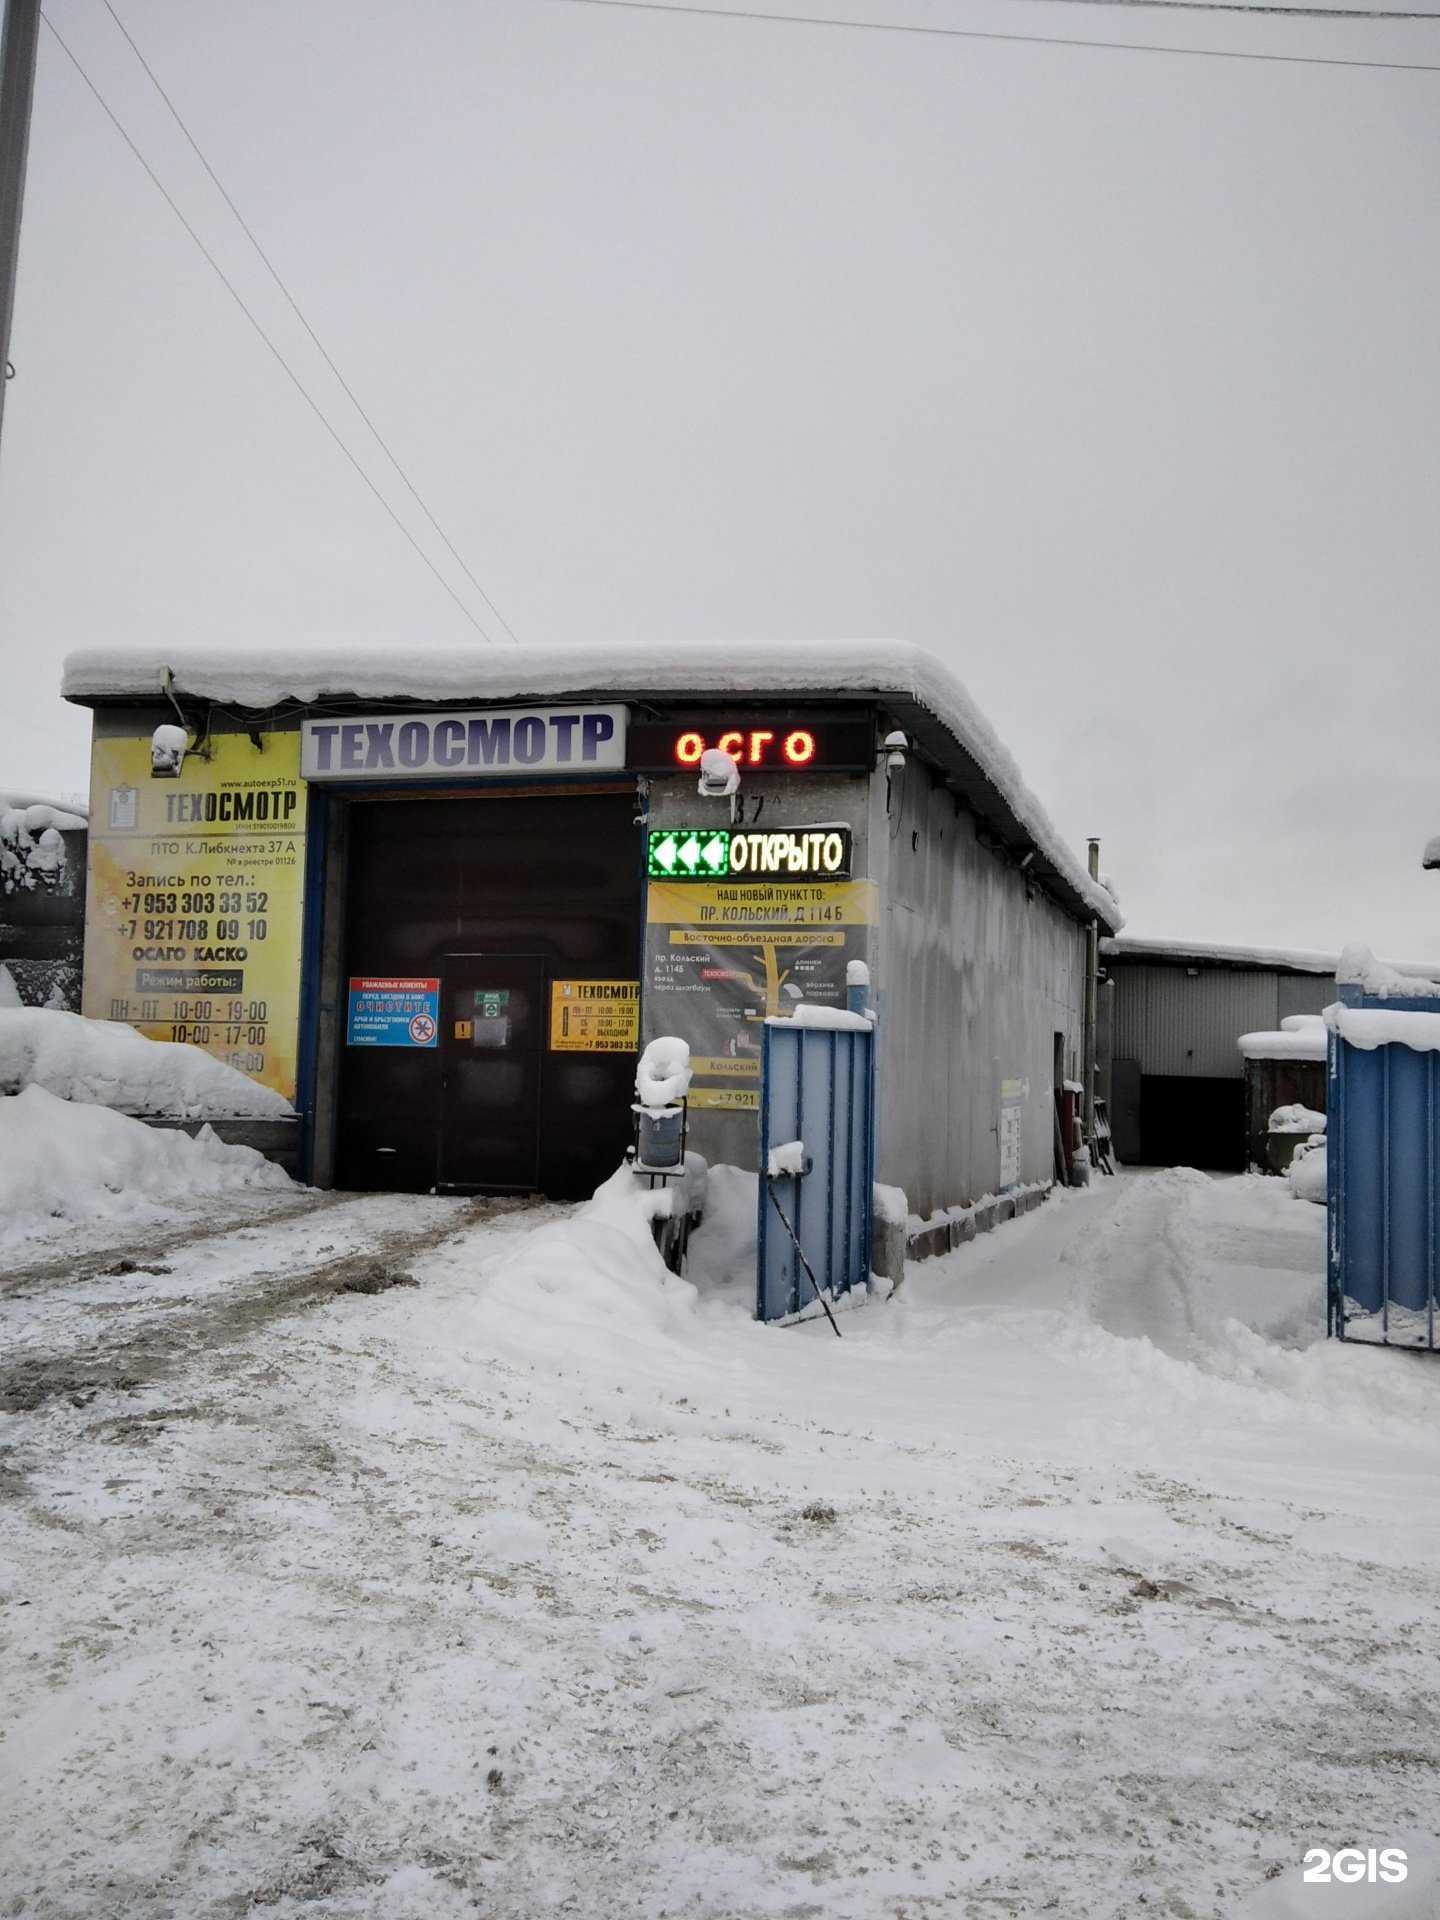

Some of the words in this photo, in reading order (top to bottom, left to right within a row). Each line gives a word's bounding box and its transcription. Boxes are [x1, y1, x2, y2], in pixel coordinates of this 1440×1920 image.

[311, 714, 614, 770] ТЕХОСМОТР
[221, 778, 297, 790] www.autoexp51.ru
[166, 791, 297, 822] ТЕХОСМОТР
[151, 843, 180, 855] ПТО
[268, 841, 282, 853] 37
[286, 840, 296, 852] А
[729, 832, 843, 872] ОТКРЫТО
[126, 871, 186, 888] Запись
[190, 875, 211, 887] по
[717, 889, 739, 900] НАШ
[740, 887, 773, 901] НОВЫЙ
[775, 888, 809, 901] ПУНКТ
[121, 893, 141, 914] +7
[144, 893, 177, 914] 953
[181, 893, 215, 914] 303
[219, 893, 243, 914] 33
[246, 892, 269, 913] 52
[700, 905, 719, 921] ПР.
[117, 920, 137, 940] +7
[216, 920, 239, 940] 09
[248, 920, 267, 940] 10
[683, 932, 792, 944] Восточно-объездная
[796, 934, 834, 945] дорога
[132, 947, 186, 962] ОСАГО
[193, 947, 248, 961] КАСКО
[670, 953, 711, 963] Кольский
[142, 974, 183, 987] Режим
[186, 974, 238, 988] работы:
[577, 985, 640, 999] ТЕХОСМОТР
[111, 999, 129, 1018] ПН
[142, 999, 159, 1018] ПТ
[173, 1001, 212, 1020] 10-00
[227, 1001, 267, 1021] 19-00
[171, 1025, 210, 1044] 10-00
[225, 1025, 266, 1045] 17-00
[597, 1028, 629, 1037] ВЫХОДНОЙ
[710, 1061, 758, 1071] Кольский
[735, 1093, 755, 1105] 921
